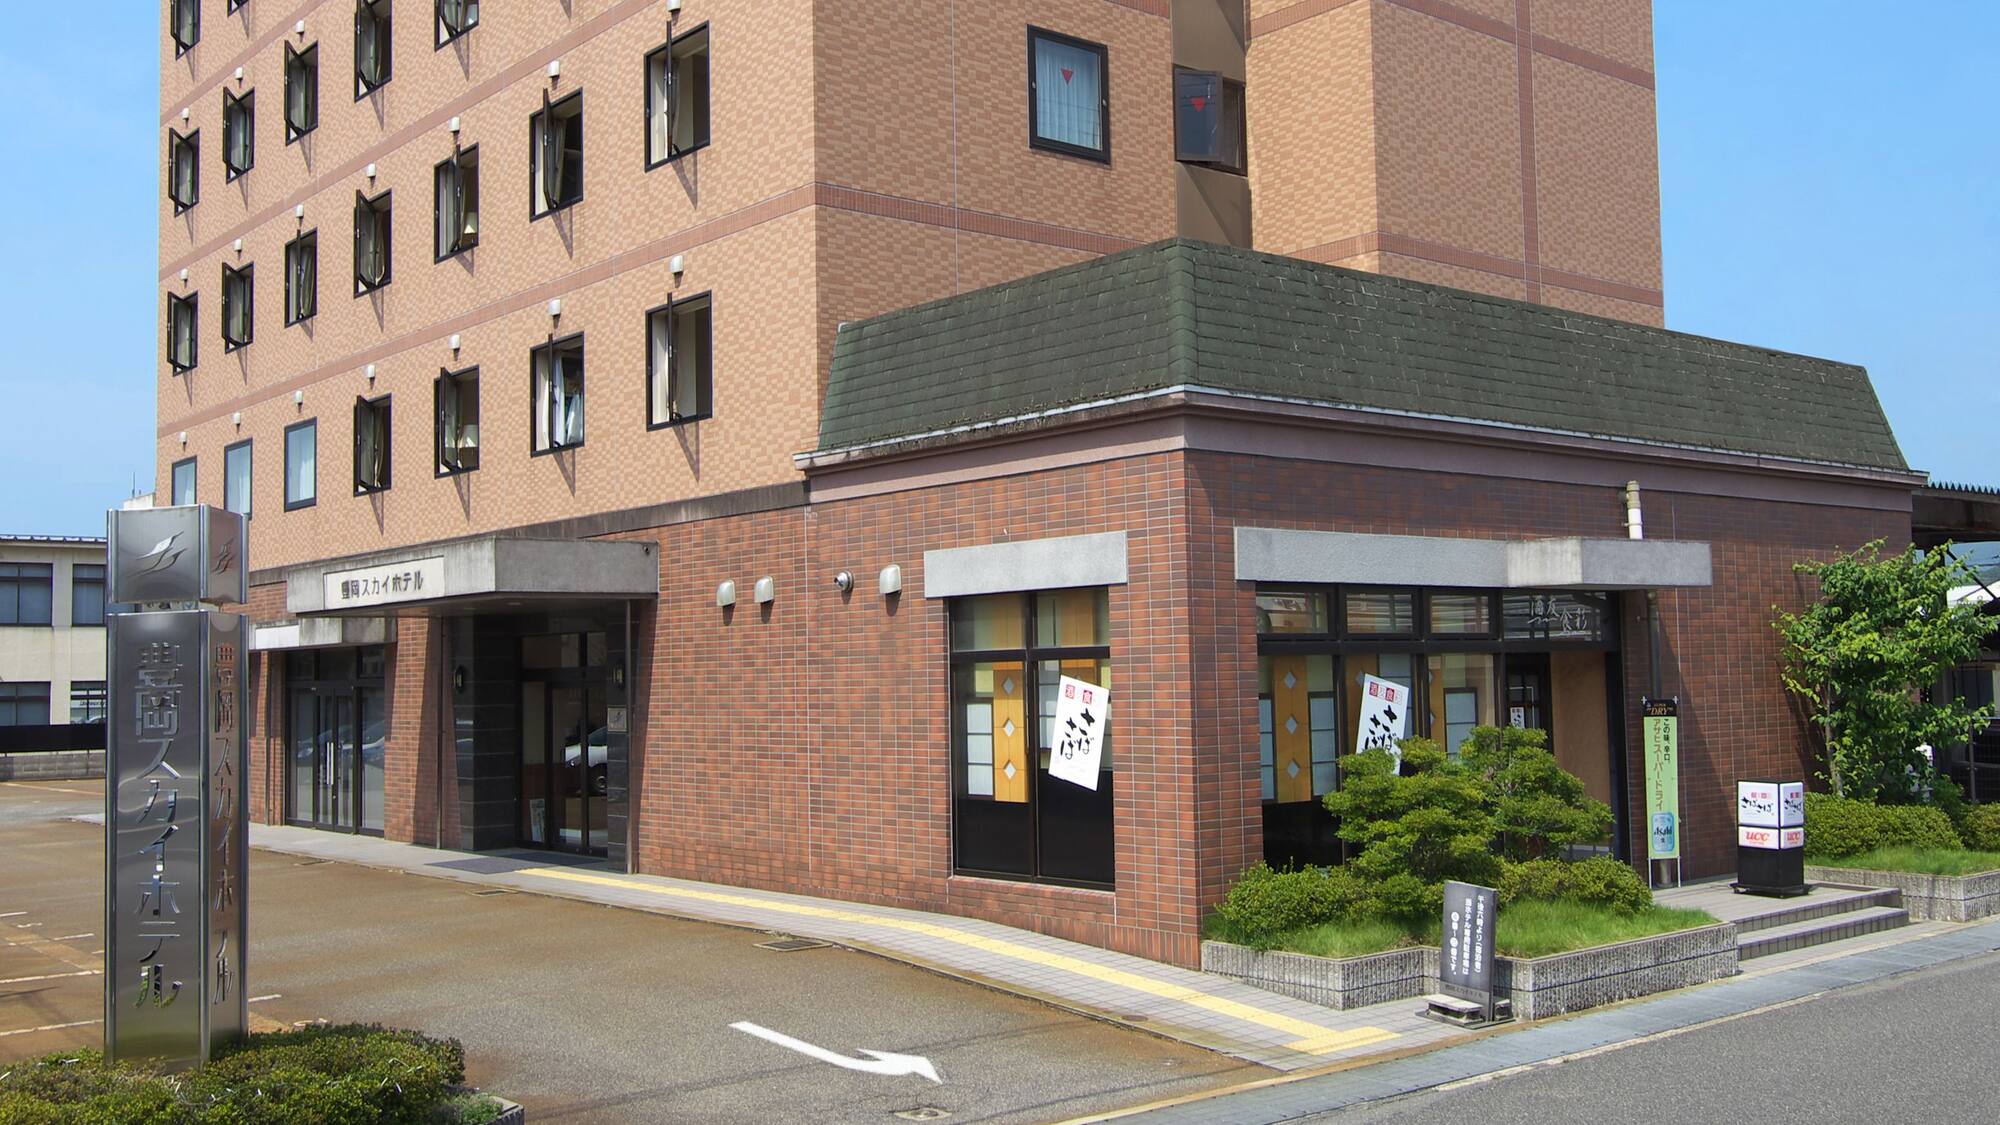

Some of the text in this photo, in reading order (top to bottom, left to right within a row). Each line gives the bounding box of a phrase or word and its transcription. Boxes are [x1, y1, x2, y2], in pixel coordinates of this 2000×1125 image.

[341, 571, 424, 600] 豊岡スカイホテル
[1653, 718, 1663, 811] アサヒスーパードライ
[133, 642, 183, 1008] 豊岡スカイホテル
[214, 644, 235, 1005] 豊岡スカイホテル
[1746, 831, 1770, 841] UCC
[1787, 831, 1801, 841] UCC
